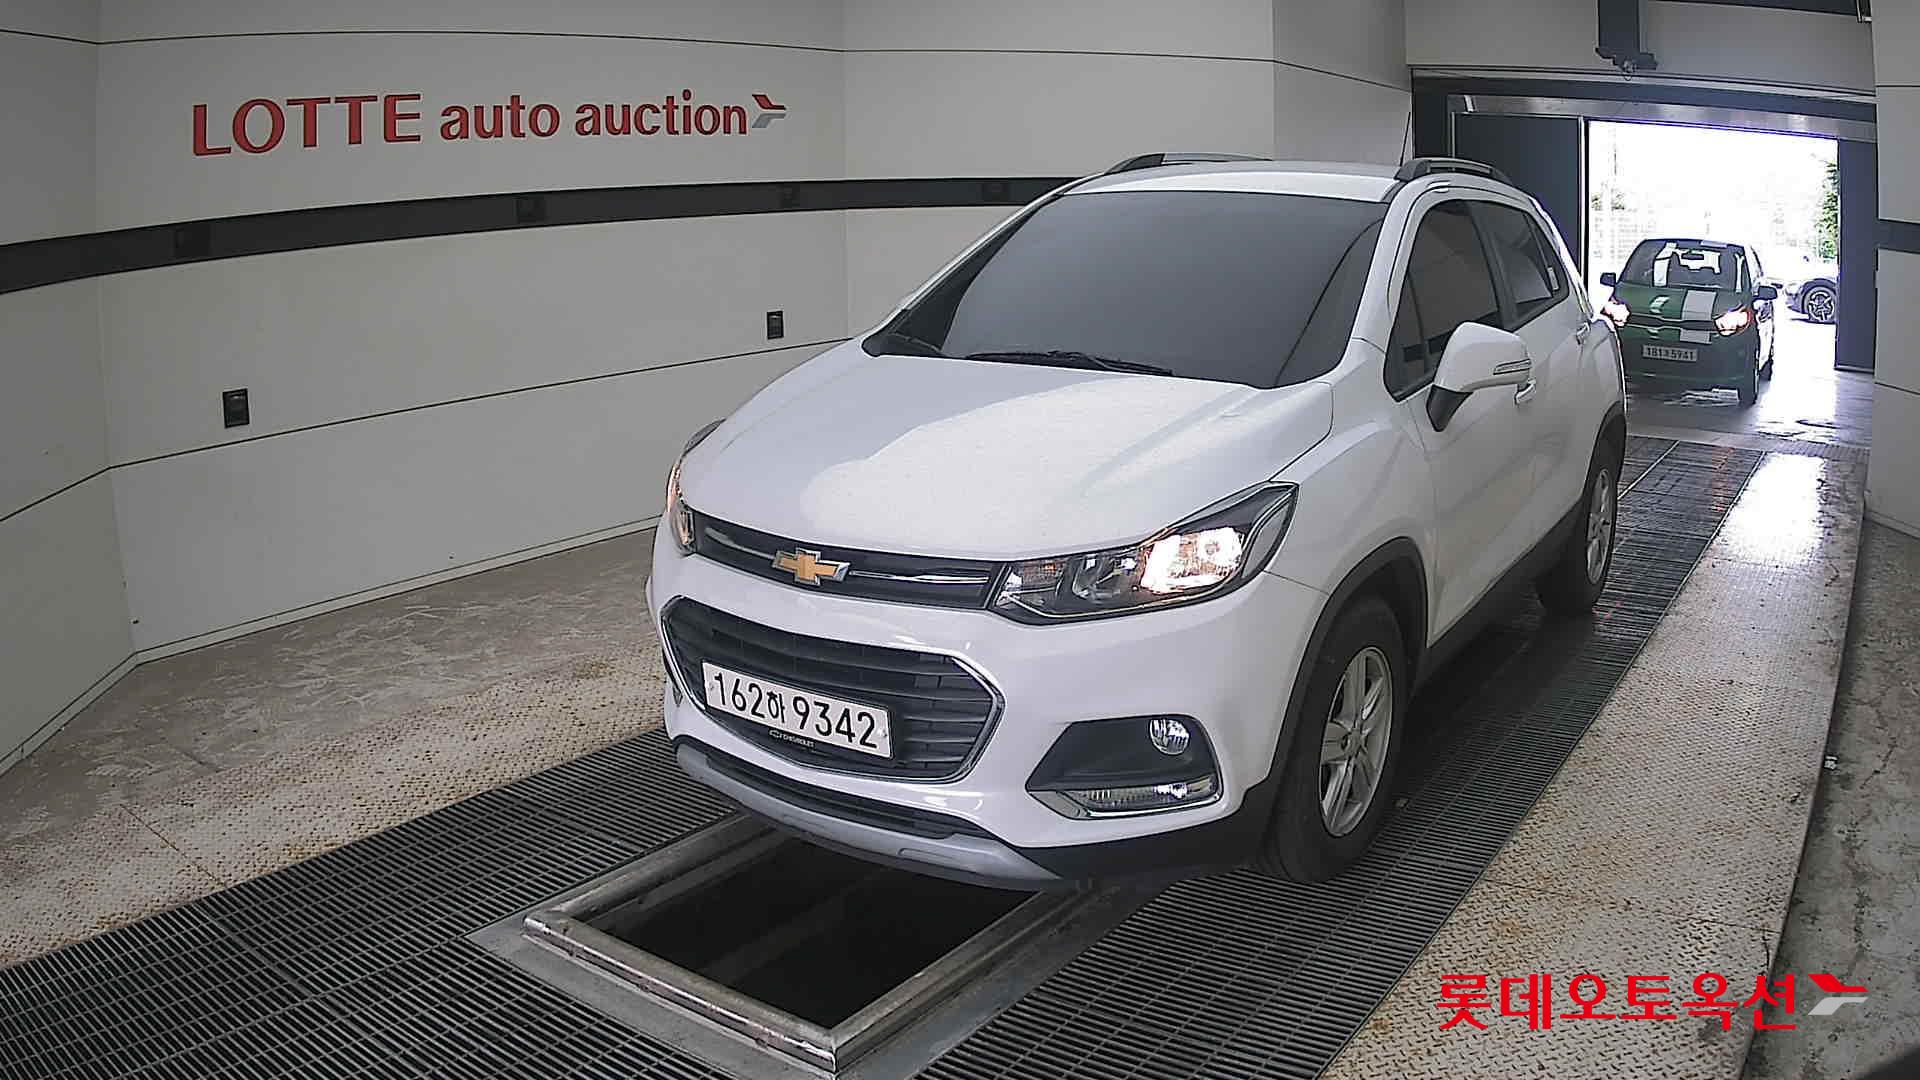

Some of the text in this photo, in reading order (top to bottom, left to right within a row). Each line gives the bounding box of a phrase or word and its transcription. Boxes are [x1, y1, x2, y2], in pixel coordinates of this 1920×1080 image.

[193, 88, 748, 157] LOTTE auto auction
[714, 672, 877, 749] 162하 9342
